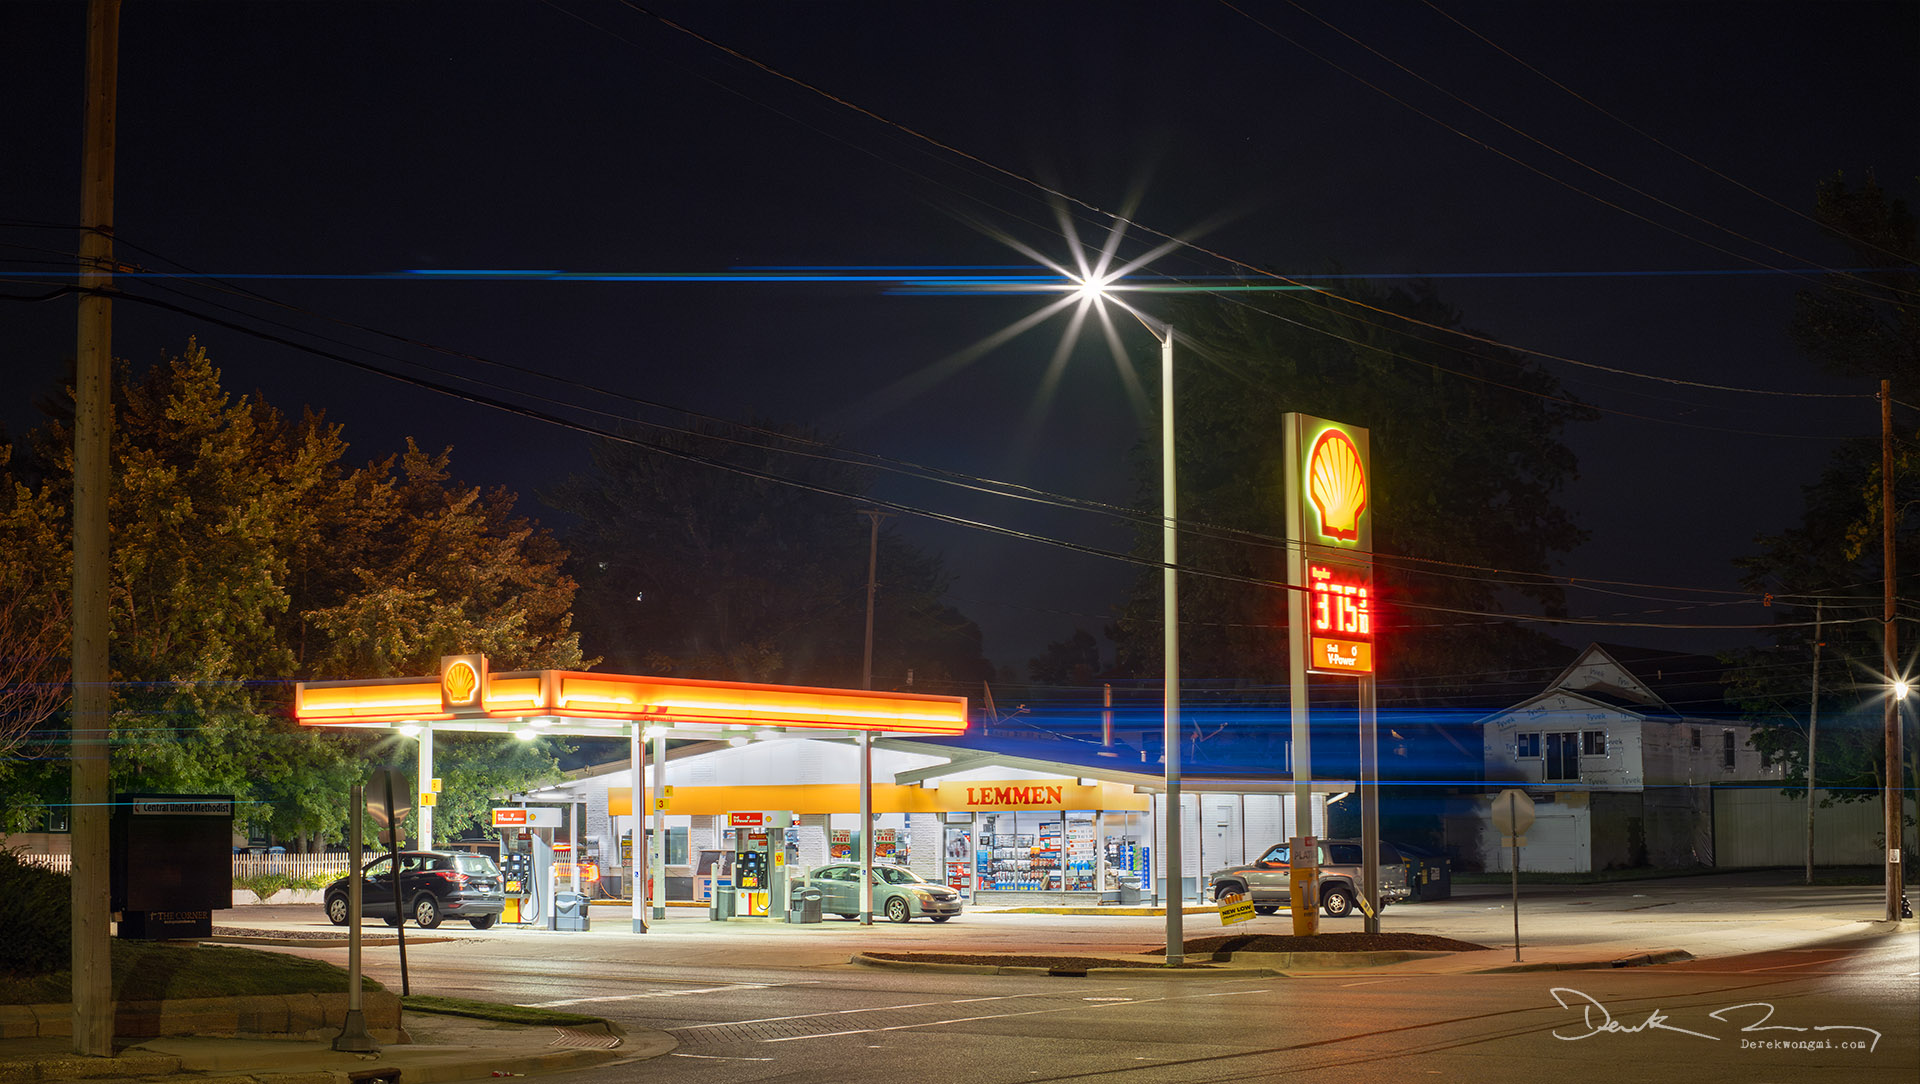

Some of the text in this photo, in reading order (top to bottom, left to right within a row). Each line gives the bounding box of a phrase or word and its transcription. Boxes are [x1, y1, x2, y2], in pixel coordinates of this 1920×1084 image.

[1327, 644, 1339, 653] Shell
[1328, 653, 1357, 666] V-Power
[1496, 716, 1516, 728] Tyvek
[1586, 713, 1607, 722] Tyvek
[1588, 779, 1608, 787] Tyvek
[1622, 778, 1642, 786] Tyvek
[966, 786, 1063, 805] LEMMEN
[143, 802, 229, 813] Central United Methodist
[658, 800, 664, 808] 3
[1298, 880, 1319, 910] 10
[159, 911, 208, 920] THE CORNER
[1222, 908, 1236, 916] NEW
